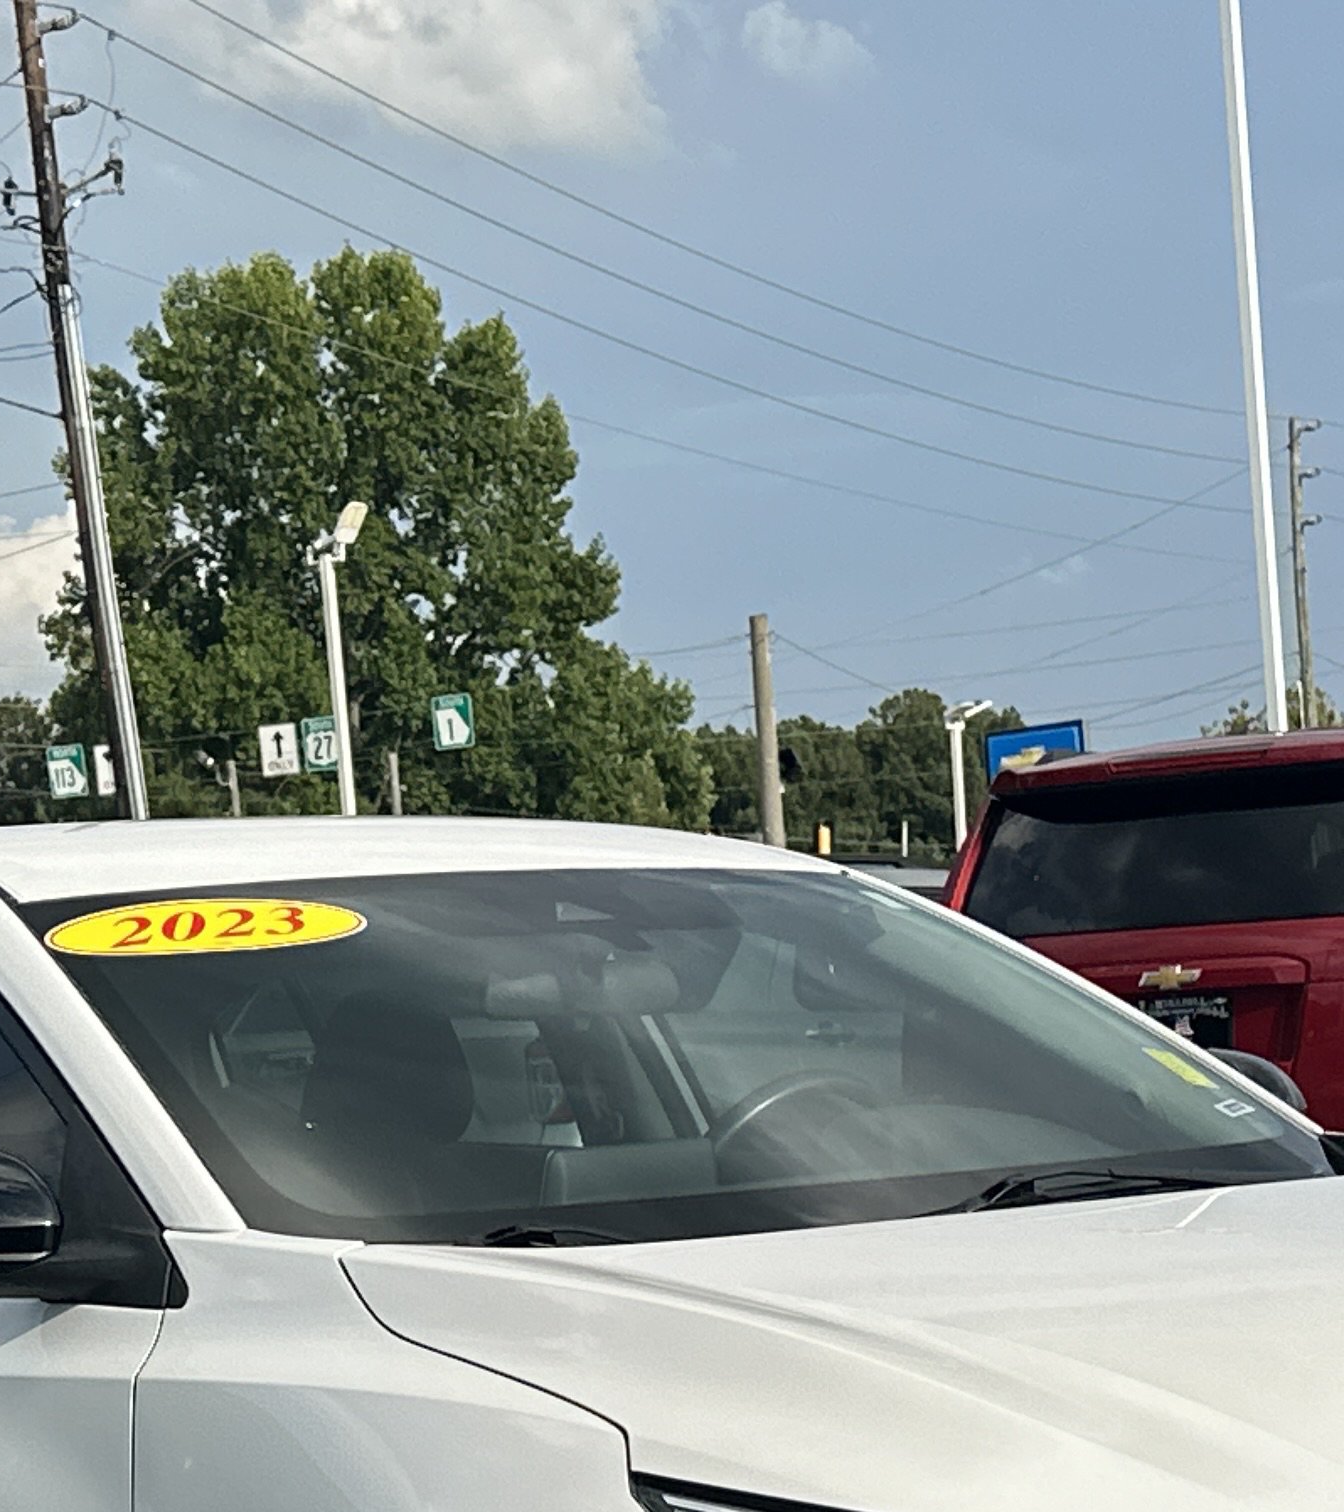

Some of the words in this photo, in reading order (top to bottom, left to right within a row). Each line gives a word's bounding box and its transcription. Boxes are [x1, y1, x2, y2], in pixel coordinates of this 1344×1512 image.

[447, 718, 454, 741] 1
[313, 734, 333, 760] 27
[54, 766, 76, 788] 113
[110, 906, 305, 948] 2023
